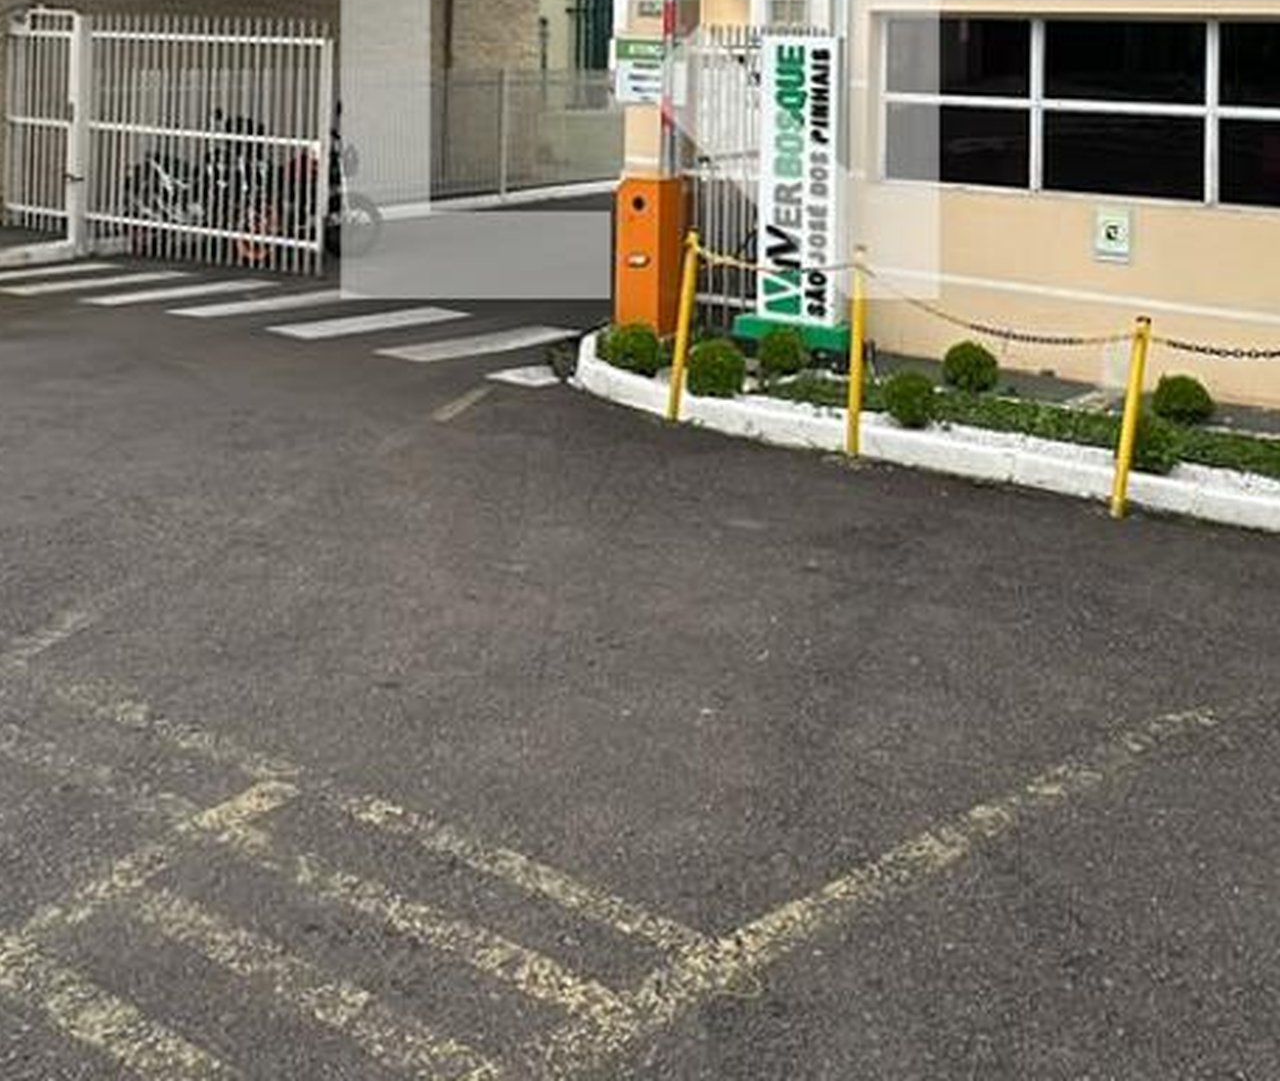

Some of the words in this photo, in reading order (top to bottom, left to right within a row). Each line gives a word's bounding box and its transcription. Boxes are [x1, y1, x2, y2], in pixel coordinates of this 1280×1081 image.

[775, 44, 807, 178] BOSQUE
[811, 48, 831, 146] PINHAIS
[809, 151, 830, 198] DOS
[807, 202, 829, 265] JOSÉ
[805, 269, 828, 317] SÃO
